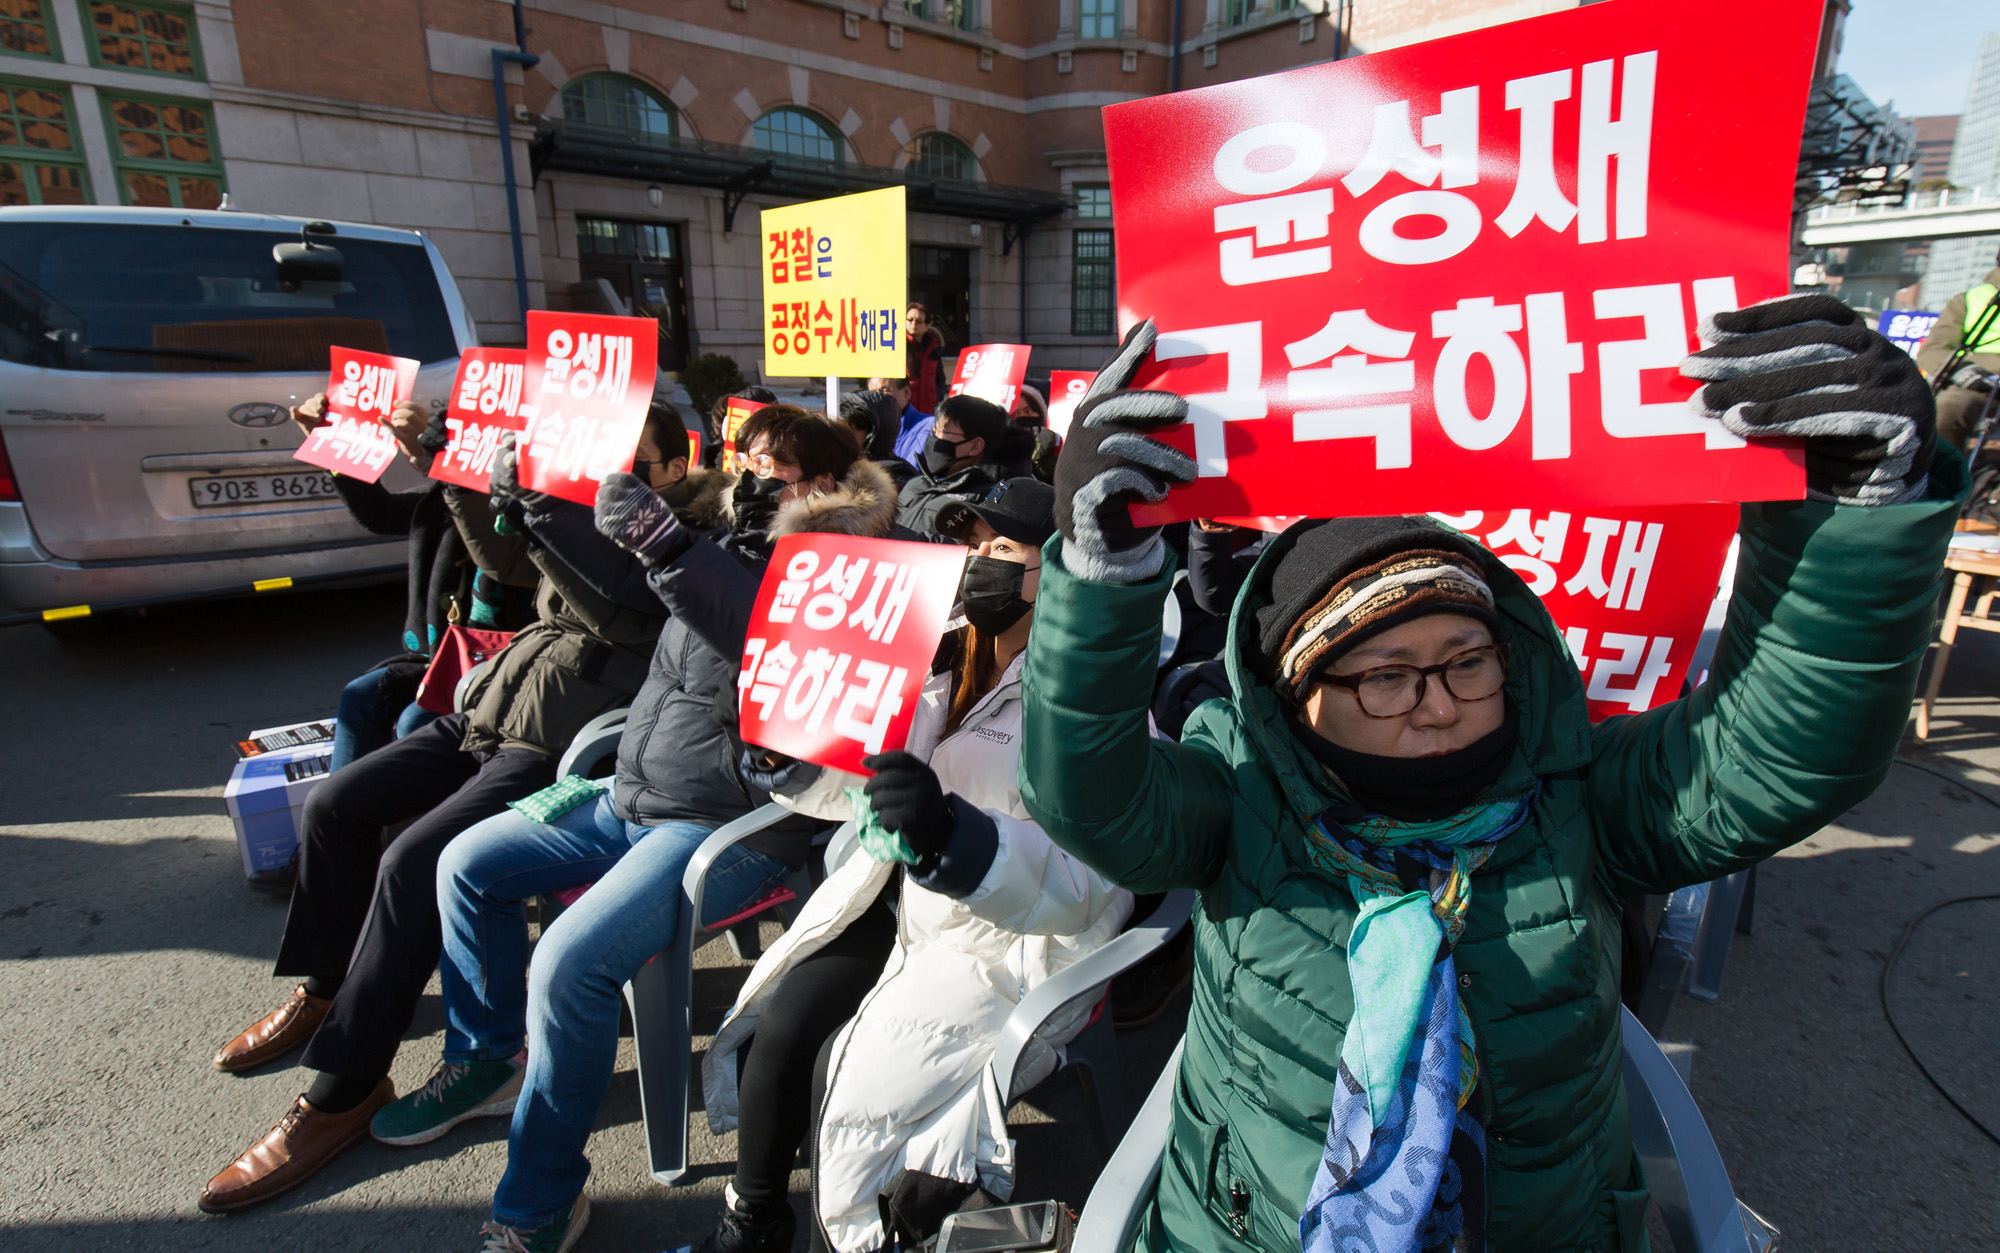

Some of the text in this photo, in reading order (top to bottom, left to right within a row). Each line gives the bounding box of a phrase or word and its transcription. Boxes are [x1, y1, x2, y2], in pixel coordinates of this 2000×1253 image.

[1213, 49, 1659, 287] 윤성재
[768, 226, 833, 284] 검찰은
[770, 296, 897, 356] 공정수사해라
[339, 360, 397, 416] 윤성재
[457, 359, 524, 417] 윤성재
[540, 328, 633, 404] 윤성재
[1154, 275, 1747, 478] 구속하라
[311, 411, 398, 471] 구속하라
[515, 403, 637, 485] 구속하라
[206, 475, 335, 502] 90조 8628
[767, 550, 921, 645] 윤성재
[737, 637, 909, 756] 구속하라
